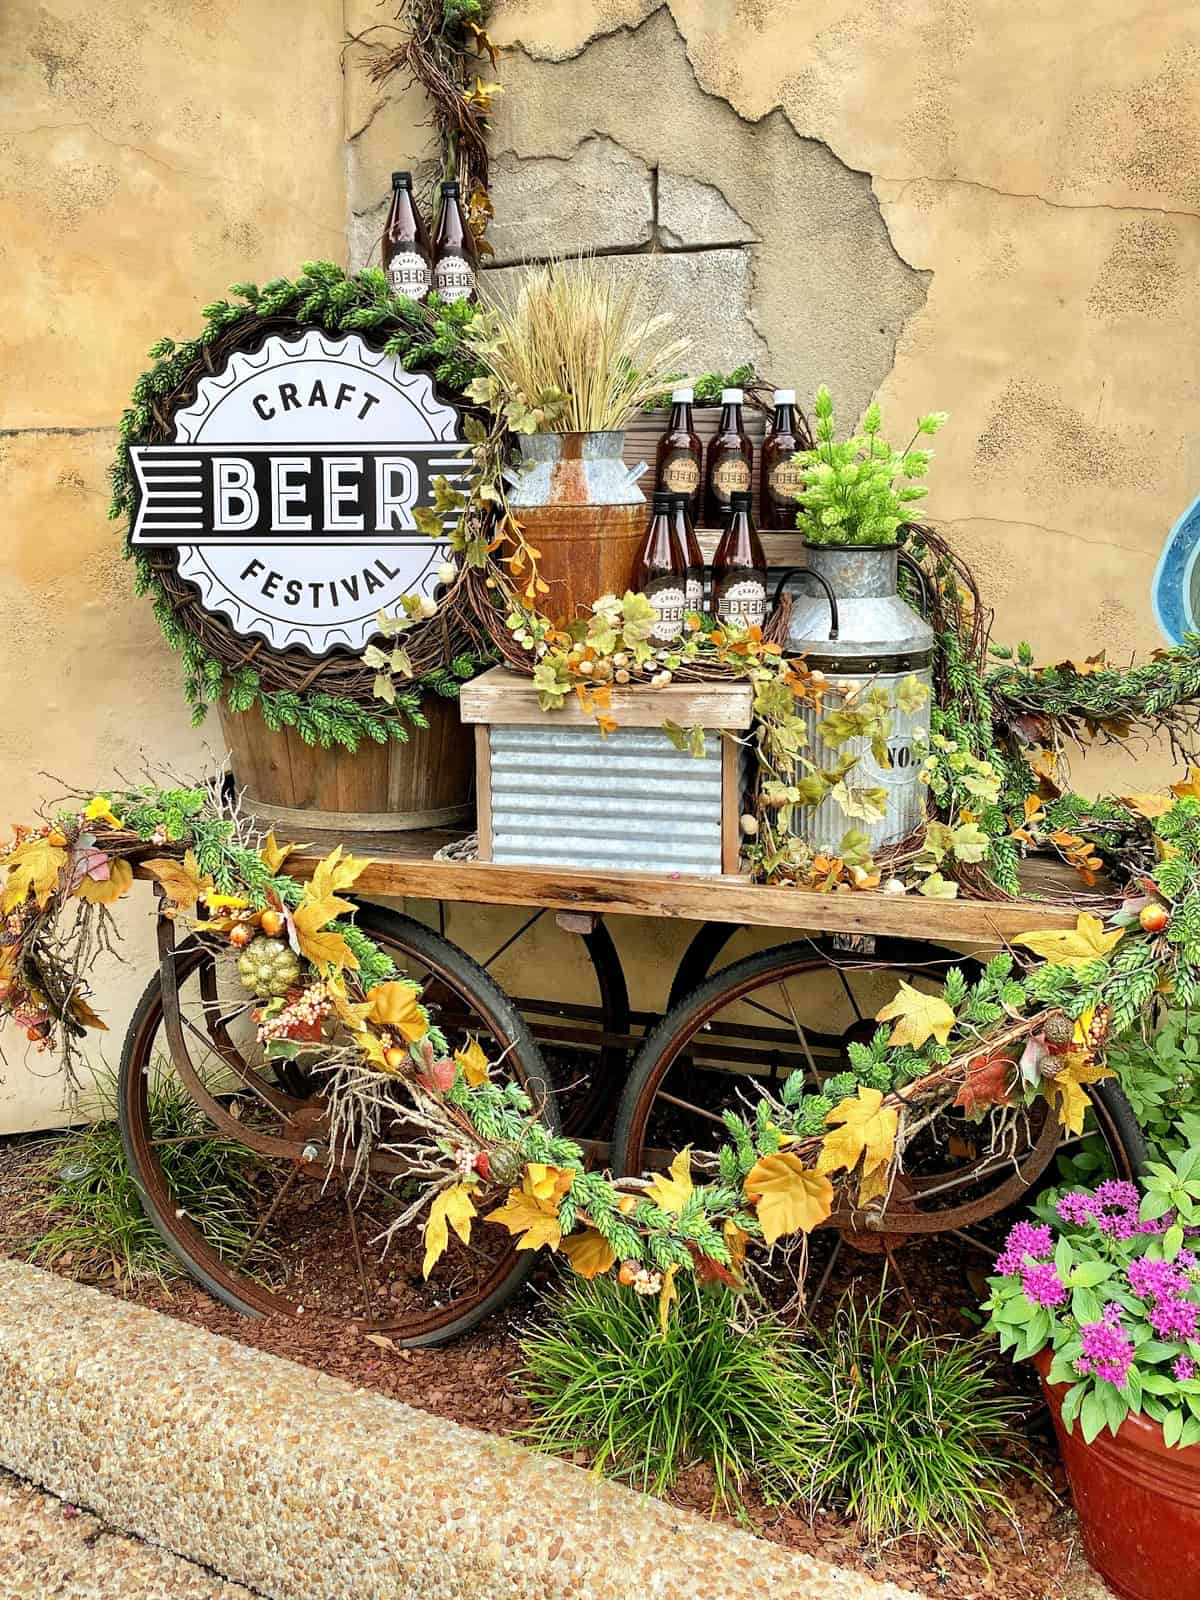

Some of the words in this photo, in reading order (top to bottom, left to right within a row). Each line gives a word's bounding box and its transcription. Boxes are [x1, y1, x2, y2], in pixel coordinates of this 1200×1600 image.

[393, 270, 424, 283] BEER
[438, 274, 468, 287] BEER
[252, 380, 380, 421] CRAFT
[211, 456, 420, 532] BEER
[239, 558, 401, 609] FESTIVAL
[730, 600, 763, 614] BEER
